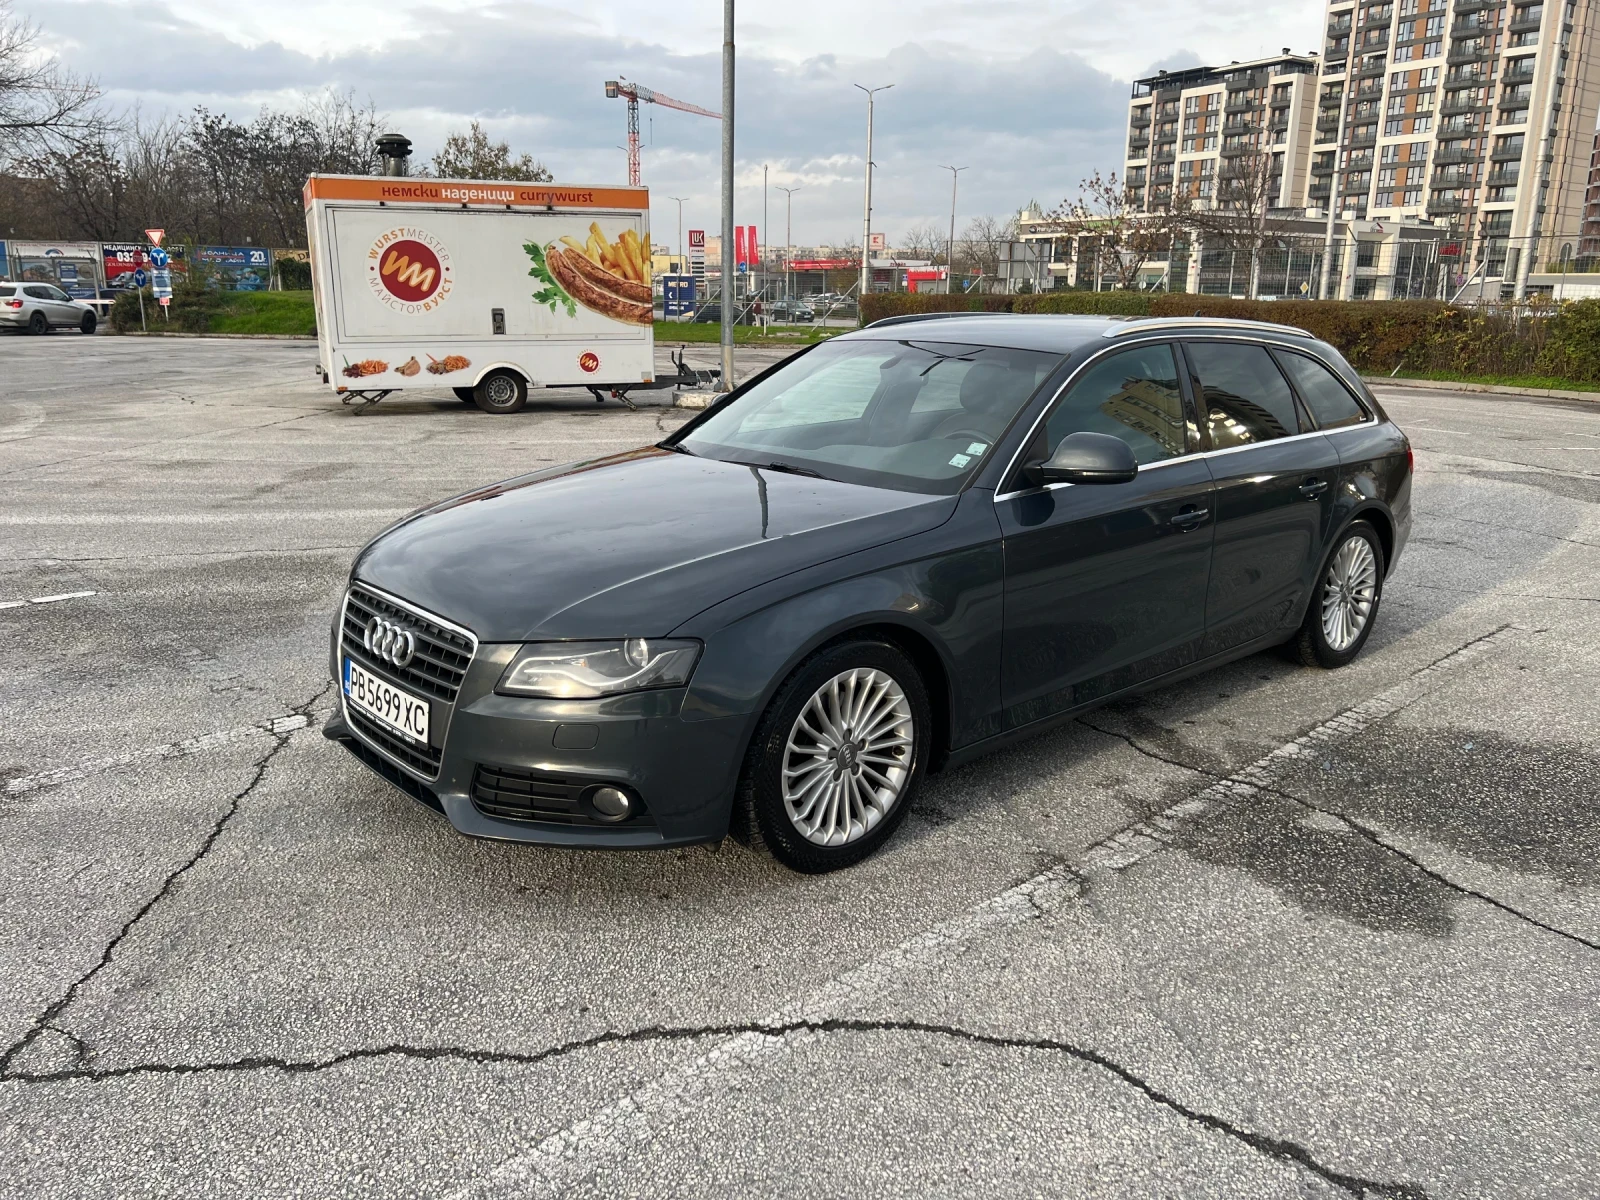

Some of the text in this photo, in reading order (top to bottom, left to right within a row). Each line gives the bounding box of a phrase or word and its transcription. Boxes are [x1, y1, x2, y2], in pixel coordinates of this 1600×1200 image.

[520, 190, 593, 203] currywurst
[368, 227, 450, 262] WURSTMEISTER
[368, 277, 453, 314] МАЙСТОРВУРСТ
